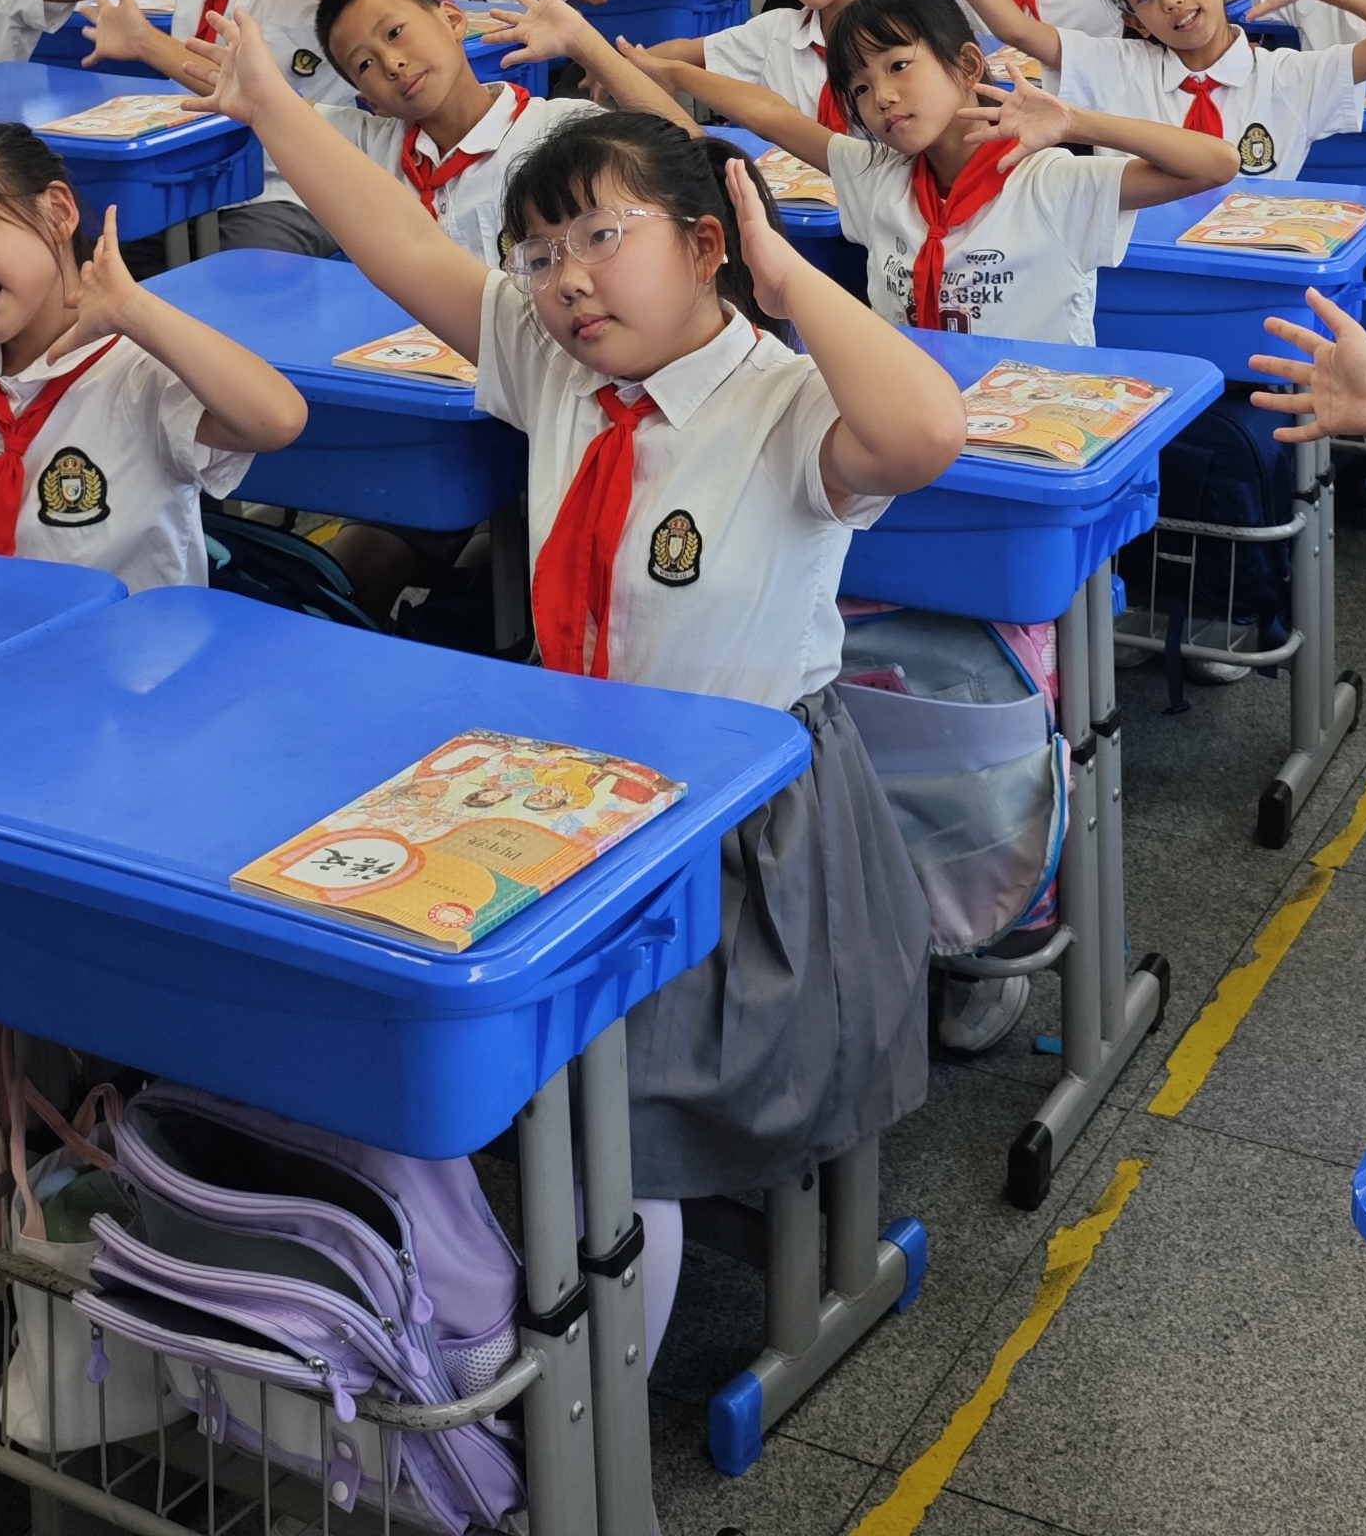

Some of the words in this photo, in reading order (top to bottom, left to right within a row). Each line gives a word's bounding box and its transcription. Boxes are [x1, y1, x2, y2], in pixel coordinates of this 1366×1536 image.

[309, 846, 397, 883] 语文
[466, 834, 524, 863] 四年级
